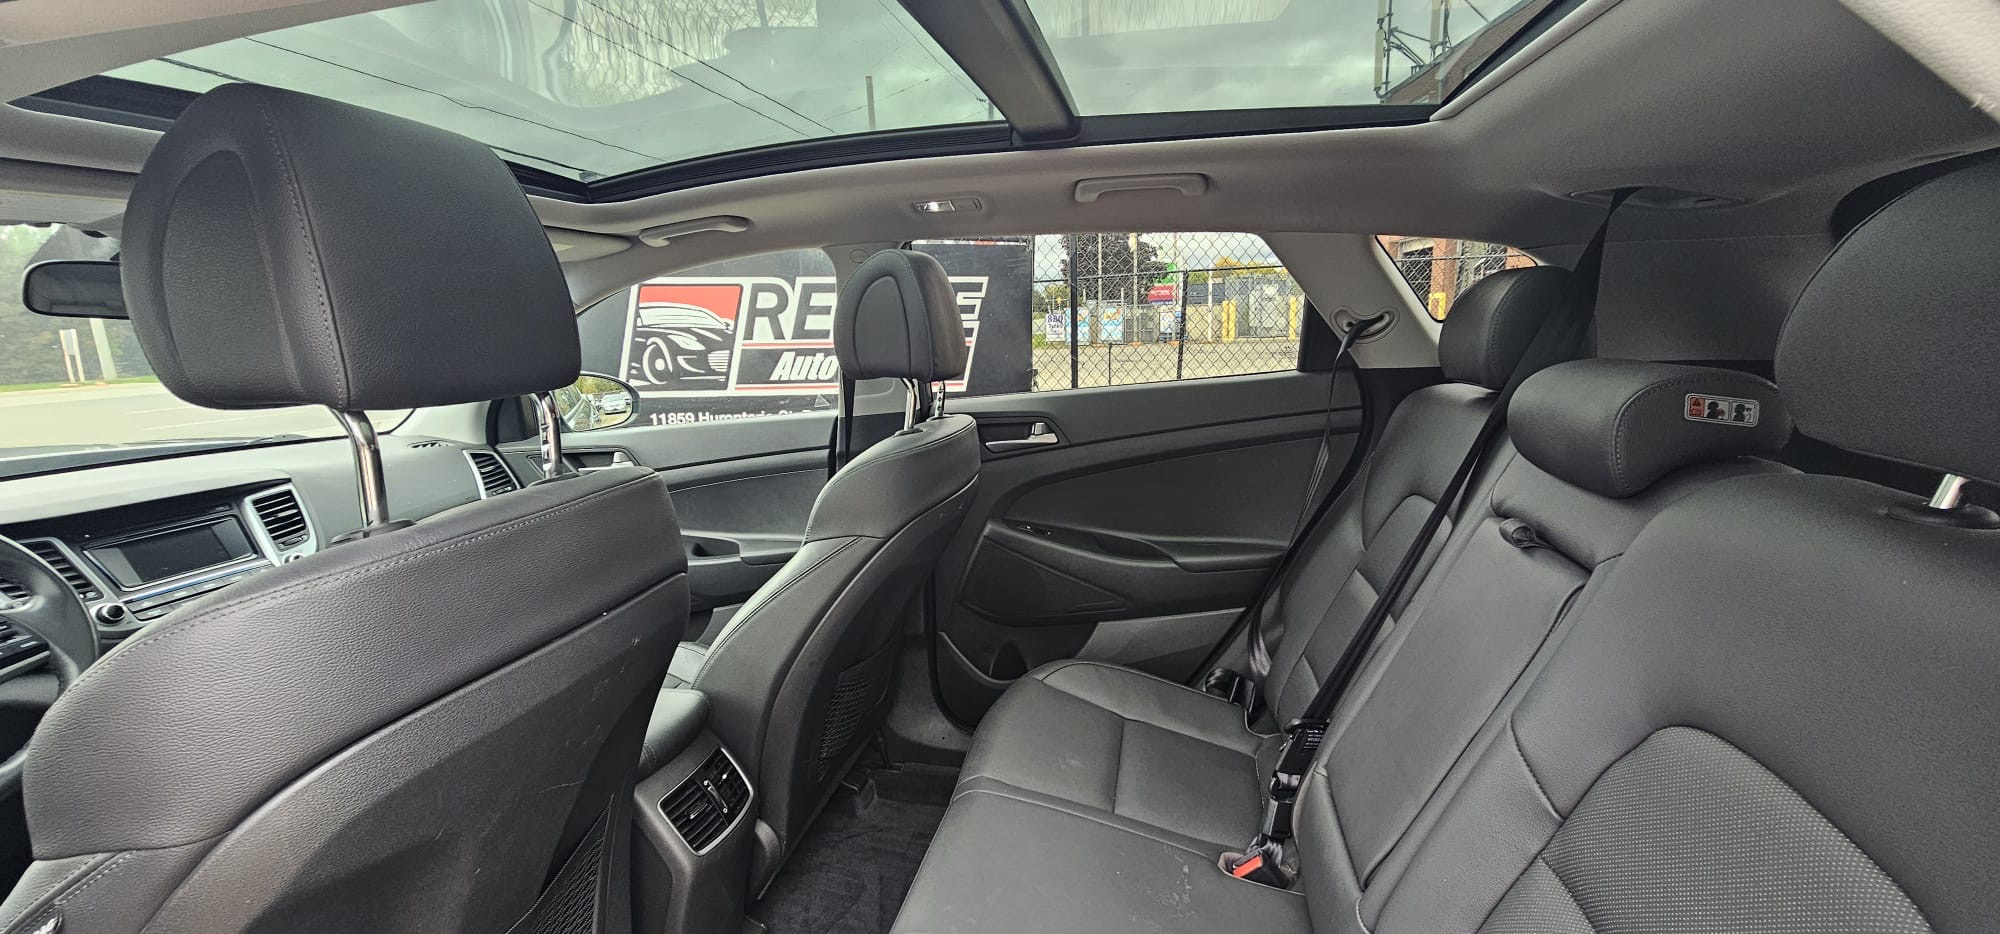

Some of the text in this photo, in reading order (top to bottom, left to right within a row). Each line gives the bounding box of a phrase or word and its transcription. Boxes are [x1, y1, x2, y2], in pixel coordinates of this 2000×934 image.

[769, 351, 838, 381] Auto
[650, 412, 694, 425] 11859
[698, 410, 773, 423] Huront
